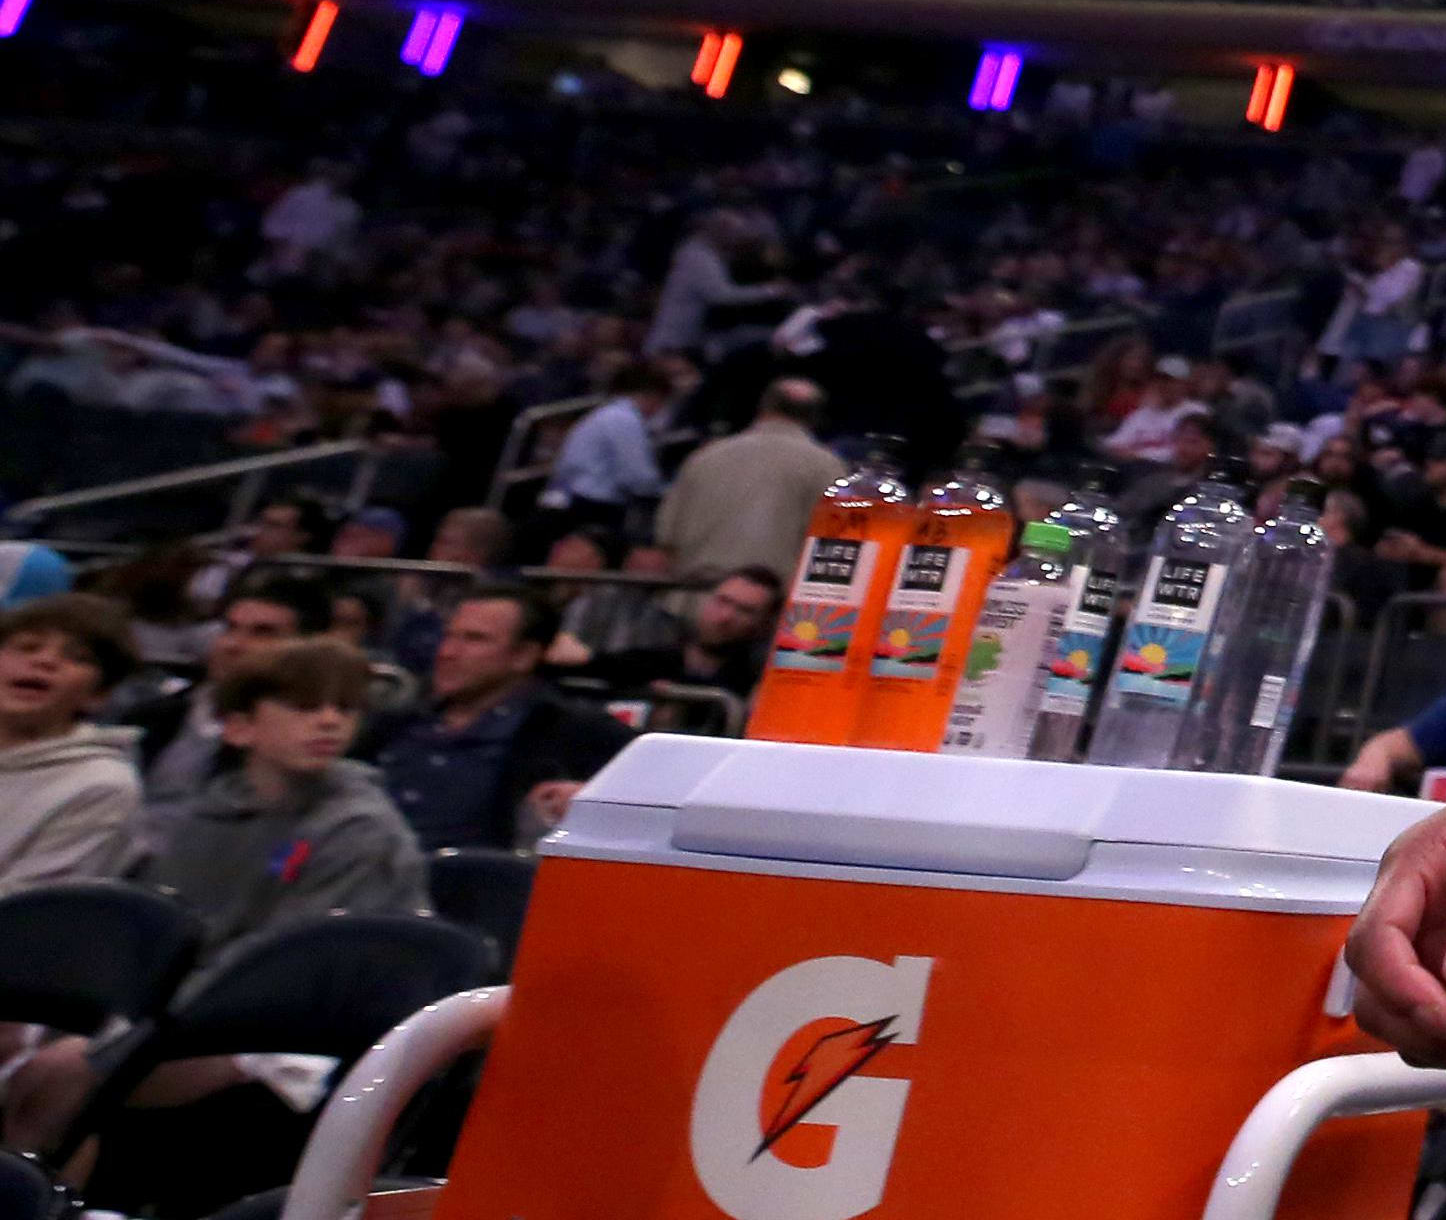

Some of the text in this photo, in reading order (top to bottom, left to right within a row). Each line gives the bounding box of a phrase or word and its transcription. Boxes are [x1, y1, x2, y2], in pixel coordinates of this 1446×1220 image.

[1161, 564, 1206, 583] LIFE
[1158, 583, 1200, 601] WTR
[690, 955, 938, 1220] G
